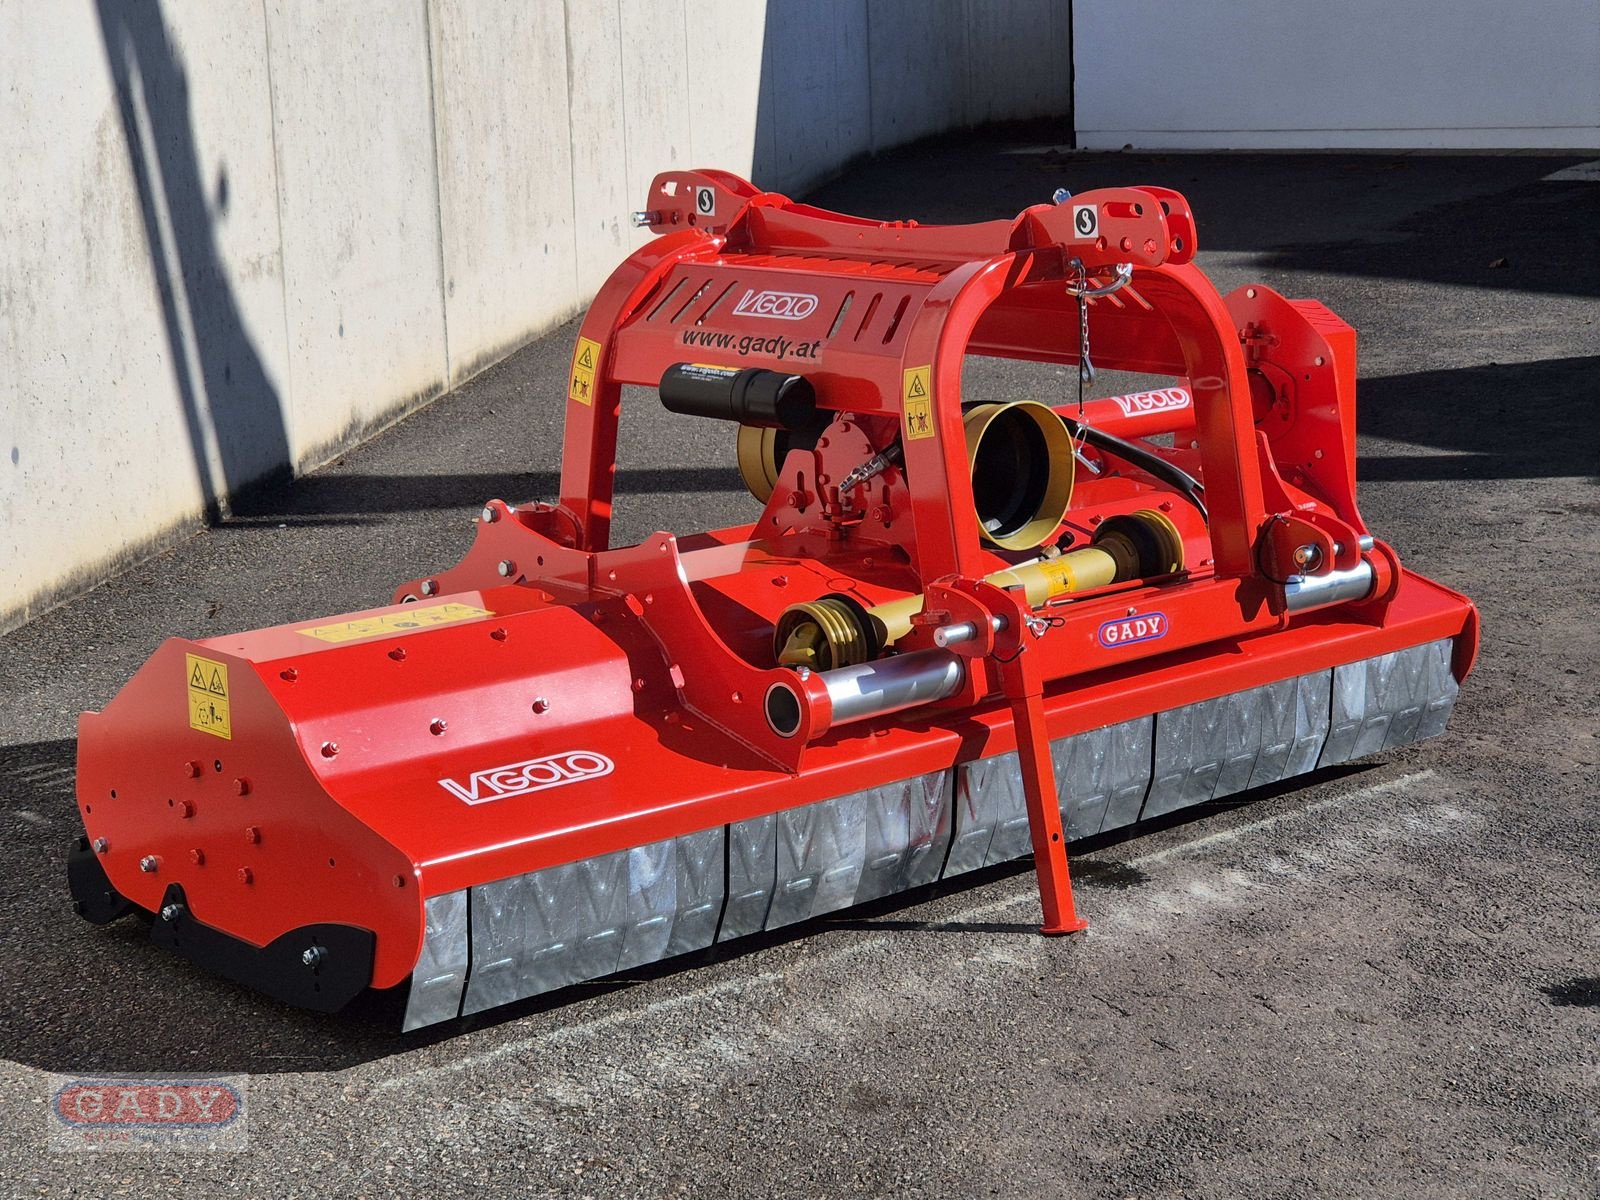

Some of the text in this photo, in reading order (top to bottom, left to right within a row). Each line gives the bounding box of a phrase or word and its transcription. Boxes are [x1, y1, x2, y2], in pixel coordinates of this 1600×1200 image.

[732, 289, 819, 321] VIGOLO
[682, 329, 821, 360] www.gady.at
[1110, 387, 1190, 418] VIGOLO
[1105, 617, 1160, 643] GADY
[437, 750, 615, 806] VIGOLO
